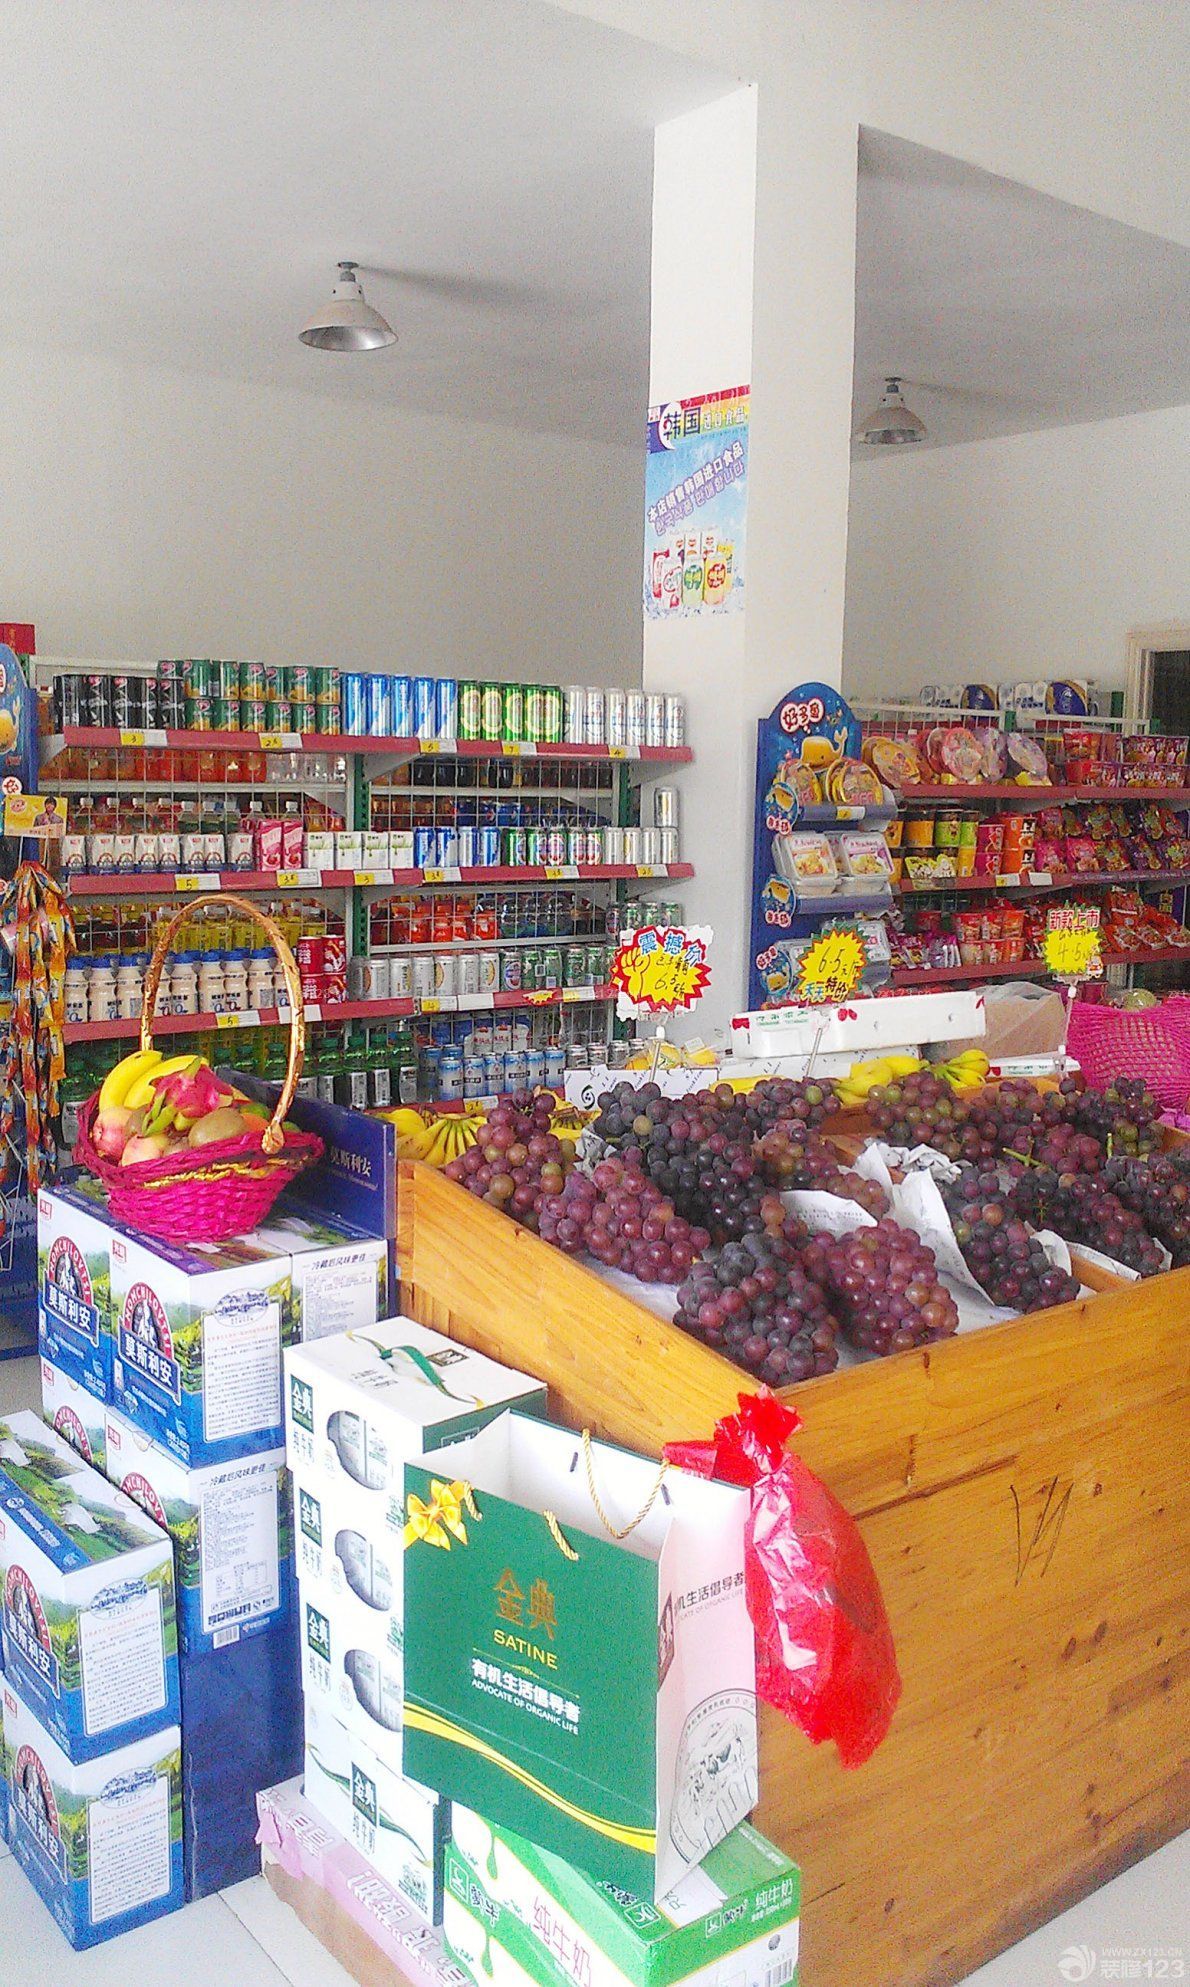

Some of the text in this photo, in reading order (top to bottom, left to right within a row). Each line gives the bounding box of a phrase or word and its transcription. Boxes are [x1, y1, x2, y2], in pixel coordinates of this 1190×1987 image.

[663, 407, 701, 441] 韩国
[782, 701, 821, 729] 好多鱼
[1049, 909, 1100, 930] 新款上市
[638, 931, 702, 967] 震撼价
[48, 1284, 91, 1332] 莫斯利安
[125, 1333, 173, 1388] 莫斯利安
[292, 1381, 313, 1420] 金典
[300, 1495, 321, 1533] 金典
[493, 1566, 559, 1642] 金典
[307, 1611, 330, 1649] 金典
[493, 1629, 558, 1671] SATINE
[471, 1657, 581, 1724] 有机生活倡导者
[471, 1678, 579, 1736] ADVOCATE OF ORGANIC LIFE
[471, 1882, 500, 1927] 蒙牛
[755, 1878, 794, 1907] 纯牛奶
[532, 1896, 593, 1987] 纯牛奶
